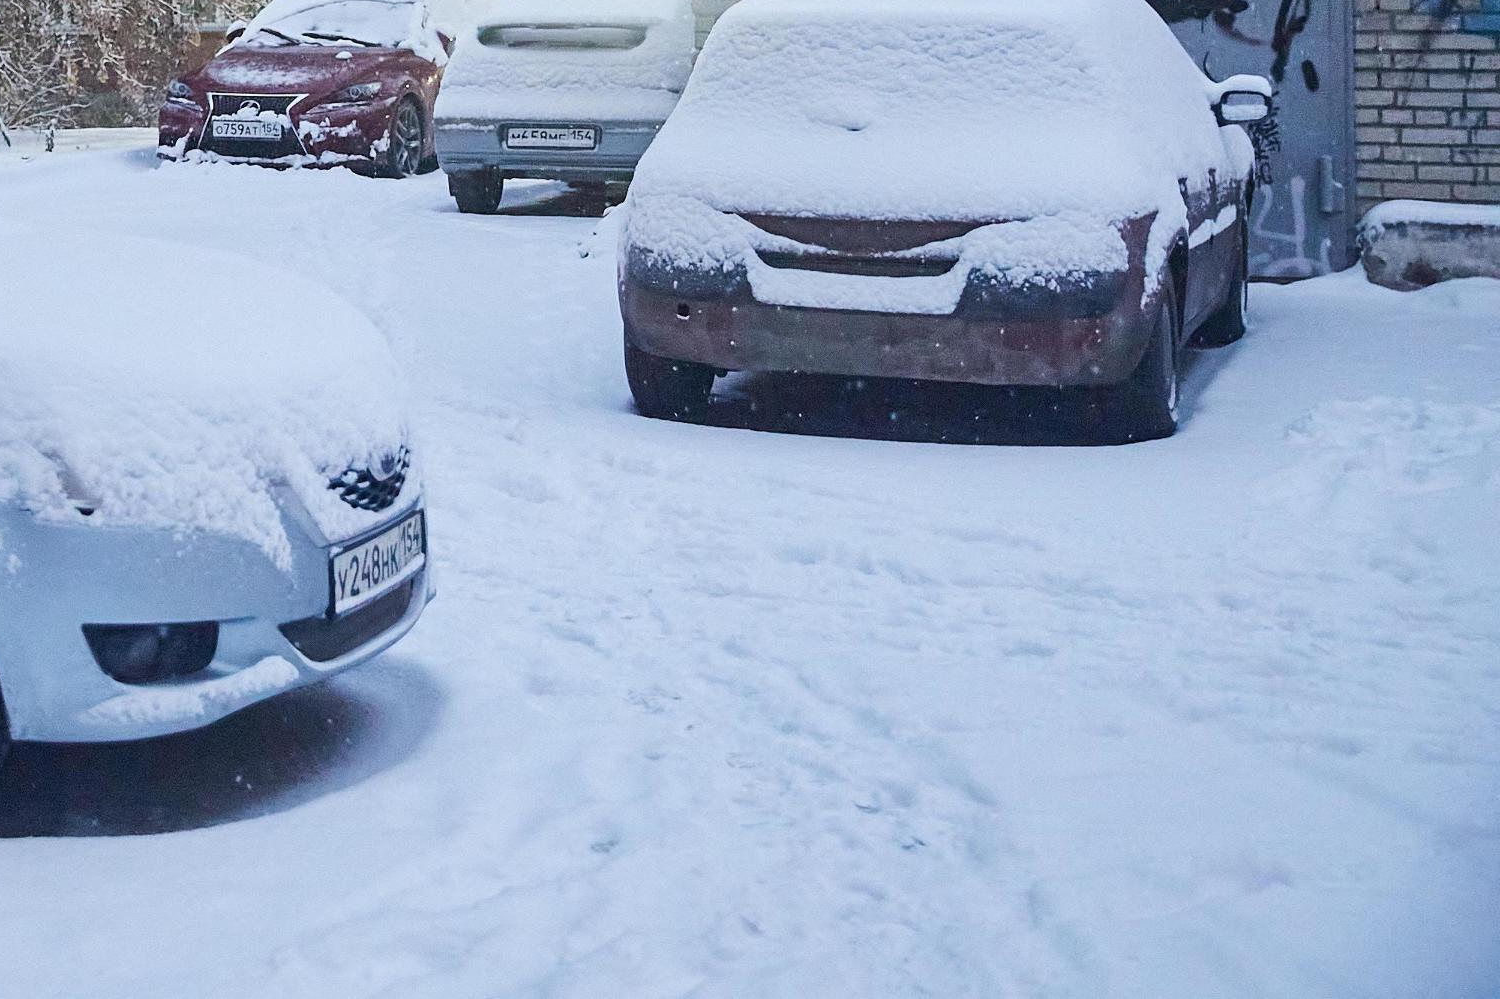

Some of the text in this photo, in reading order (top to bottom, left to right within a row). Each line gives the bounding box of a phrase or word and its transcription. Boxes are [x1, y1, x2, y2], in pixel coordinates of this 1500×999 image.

[261, 121, 279, 133] 154
[569, 129, 592, 140] 154
[338, 522, 421, 601] У248НК 154
